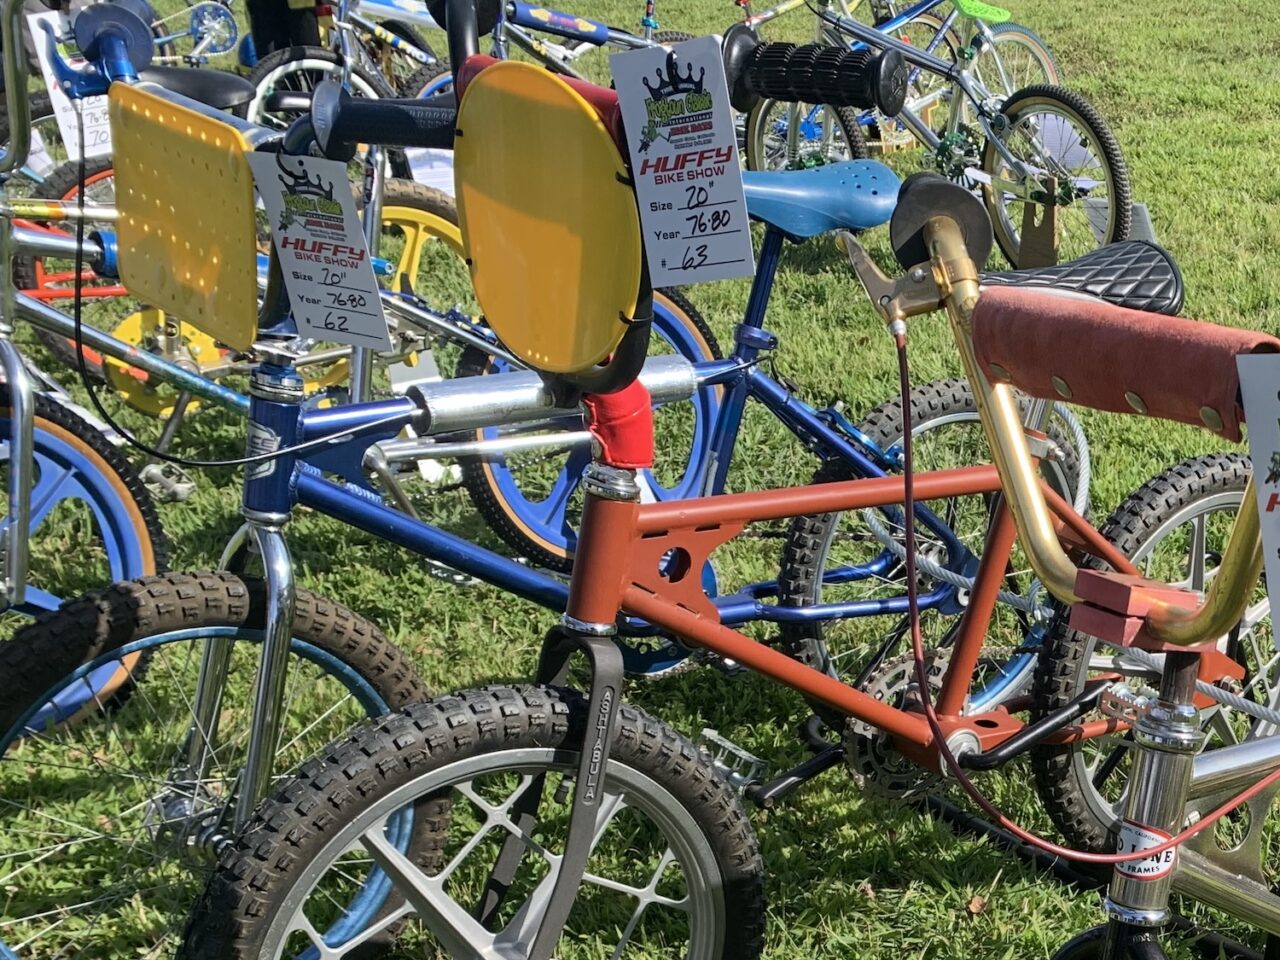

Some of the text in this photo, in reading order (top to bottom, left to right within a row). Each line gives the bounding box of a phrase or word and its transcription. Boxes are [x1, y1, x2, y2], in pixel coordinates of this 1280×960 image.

[90, 130, 108, 147] 70
[640, 145, 733, 176] HUFFY
[654, 165, 725, 185] BIKE SHOW
[650, 201, 672, 212] Size
[654, 230, 680, 240] Year
[281, 236, 365, 261] HUFFY
[681, 244, 708, 270] 63
[294, 252, 358, 269] BIKE SHOW
[292, 271, 313, 282] Size
[297, 294, 321, 305] Year
[324, 311, 349, 332] 62
[584, 690, 612, 799] ASHTABULA
[1127, 864, 1160, 874] FRAMES
